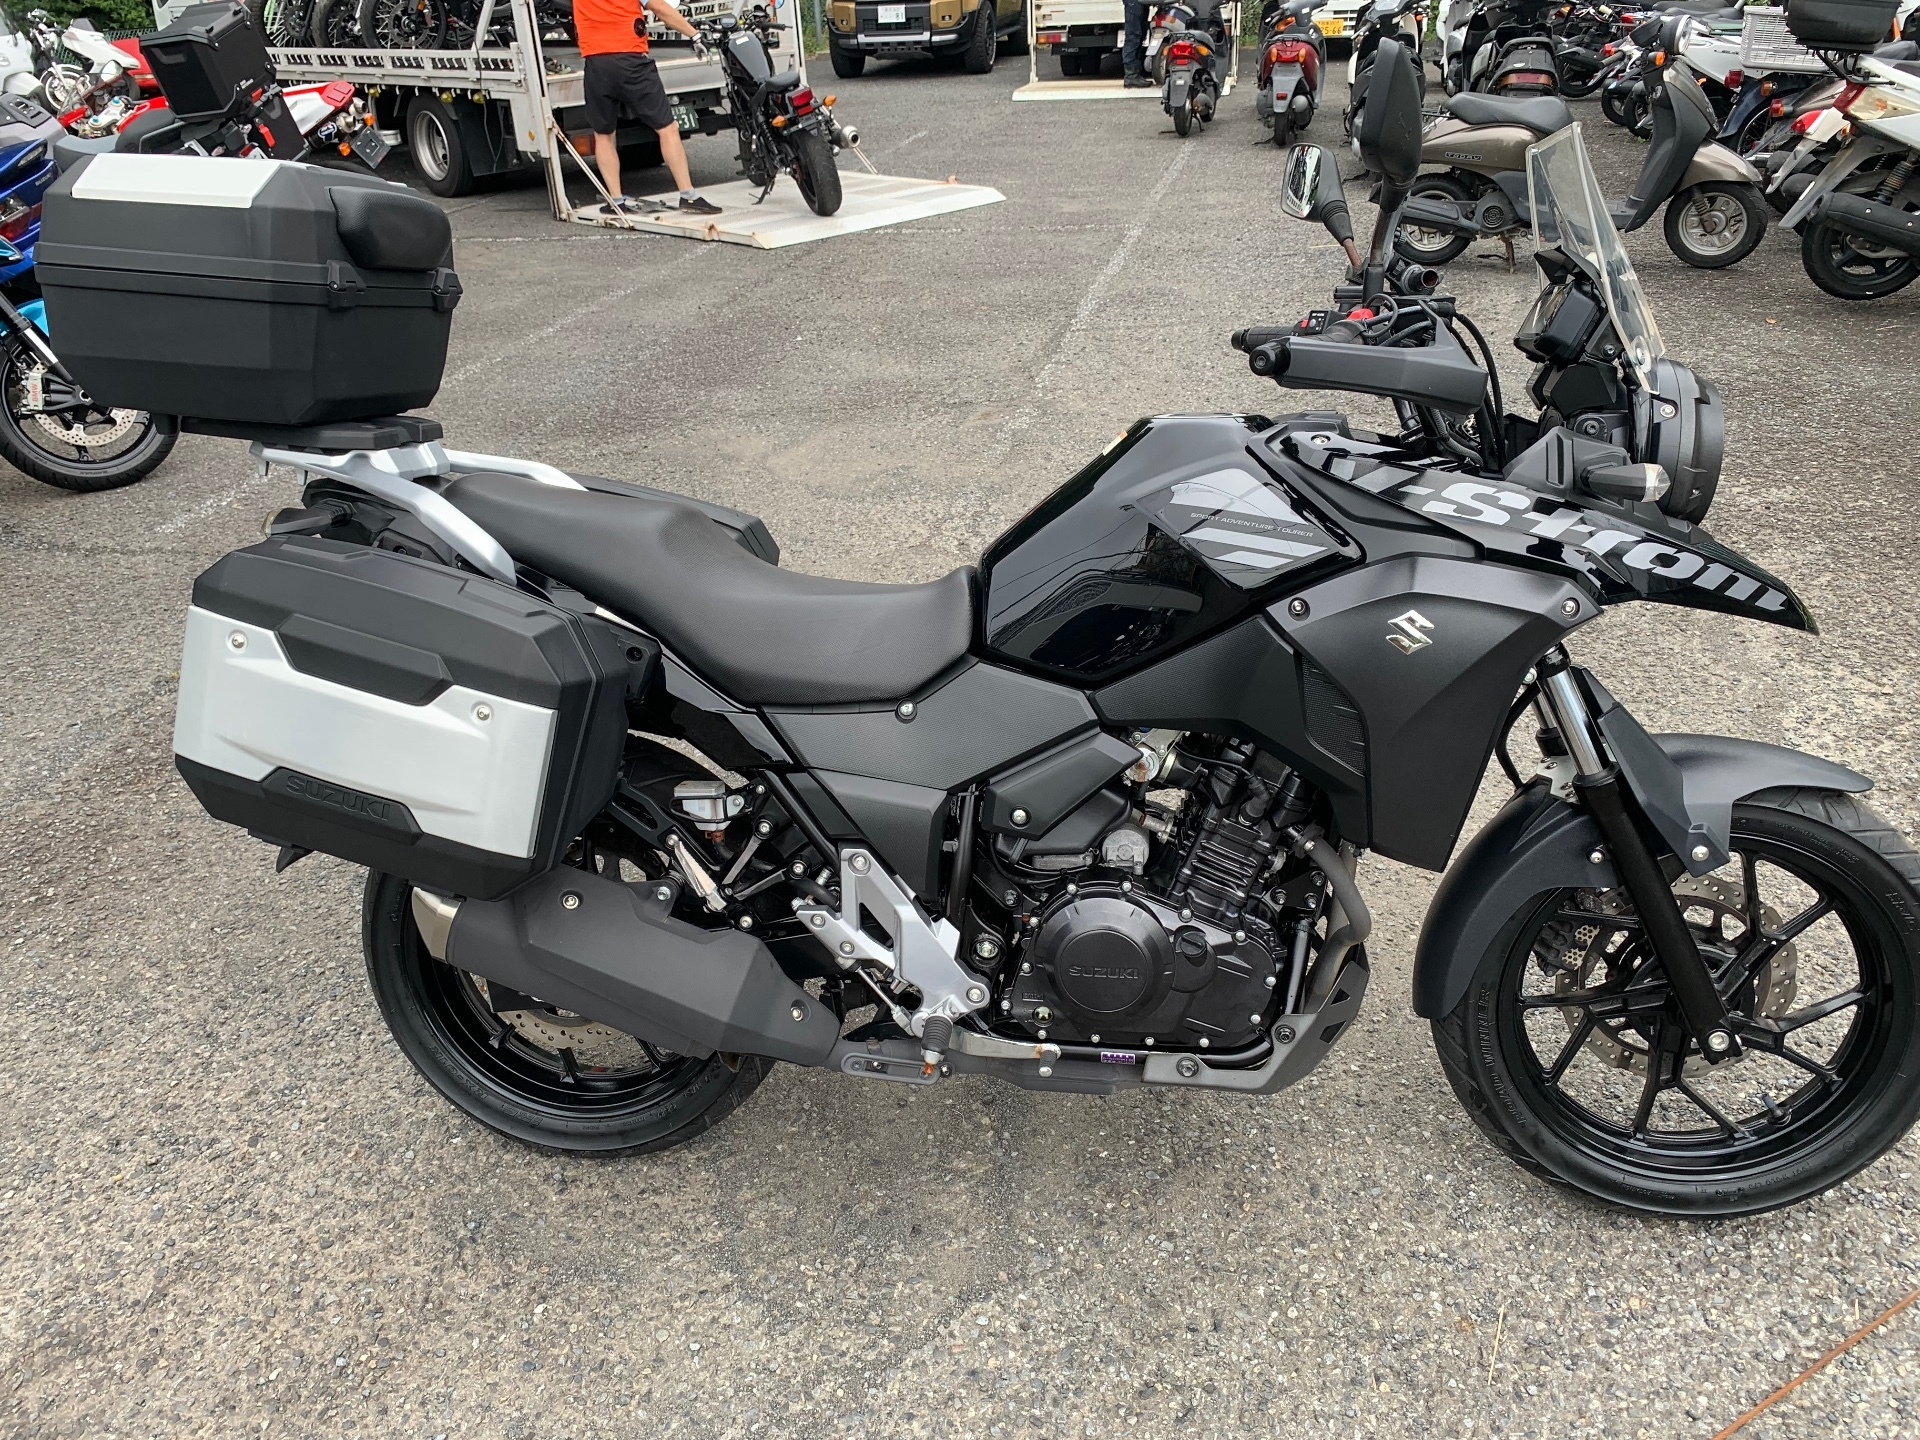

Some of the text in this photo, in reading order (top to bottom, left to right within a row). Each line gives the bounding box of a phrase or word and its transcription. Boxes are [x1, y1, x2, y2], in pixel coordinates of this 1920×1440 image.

[31, 383, 39, 402] BMW
[1190, 512, 1315, 538] SPORT ADVENTURE TOURER
[286, 775, 391, 821] SUZUKI
[1068, 965, 1139, 979] SUZUKI
